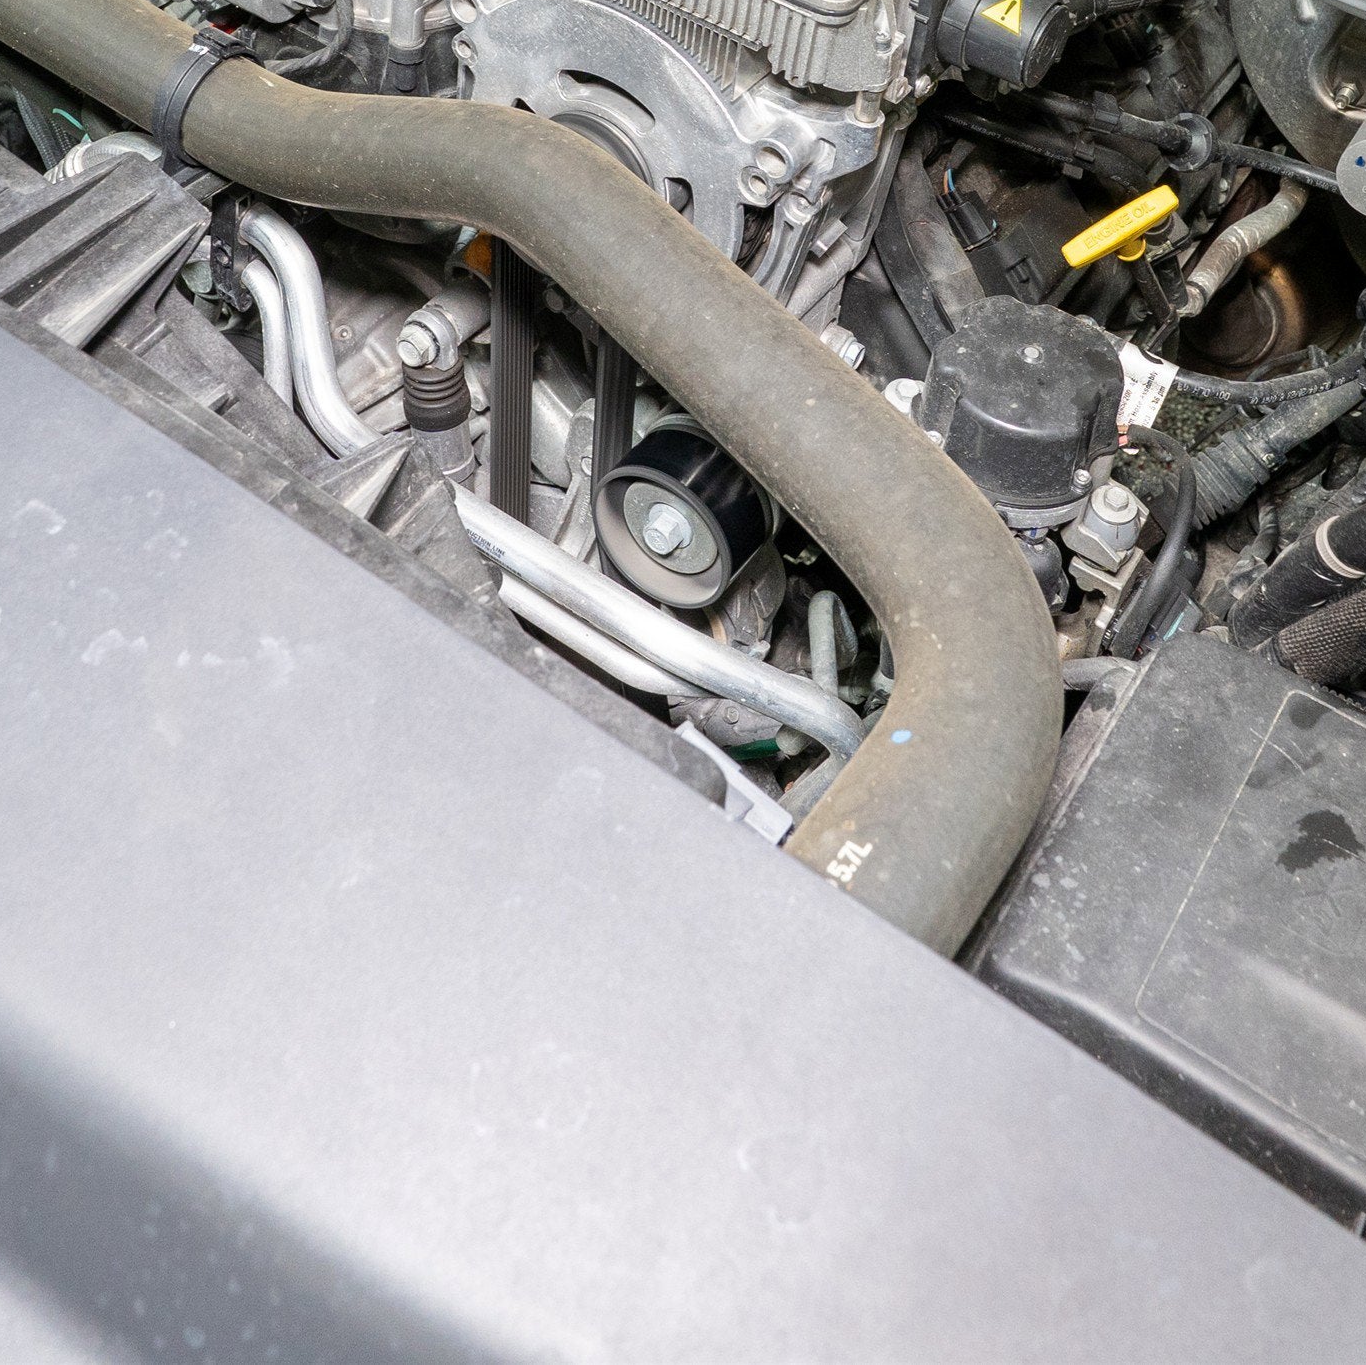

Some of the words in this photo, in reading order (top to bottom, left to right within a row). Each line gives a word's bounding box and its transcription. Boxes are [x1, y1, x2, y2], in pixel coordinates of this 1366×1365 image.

[1083, 212, 1133, 249] ENGINE
[1132, 202, 1156, 218] OIL
[465, 528, 492, 547] SUCTION
[491, 545, 506, 556] LINE
[827, 841, 872, 881] 5.7L
